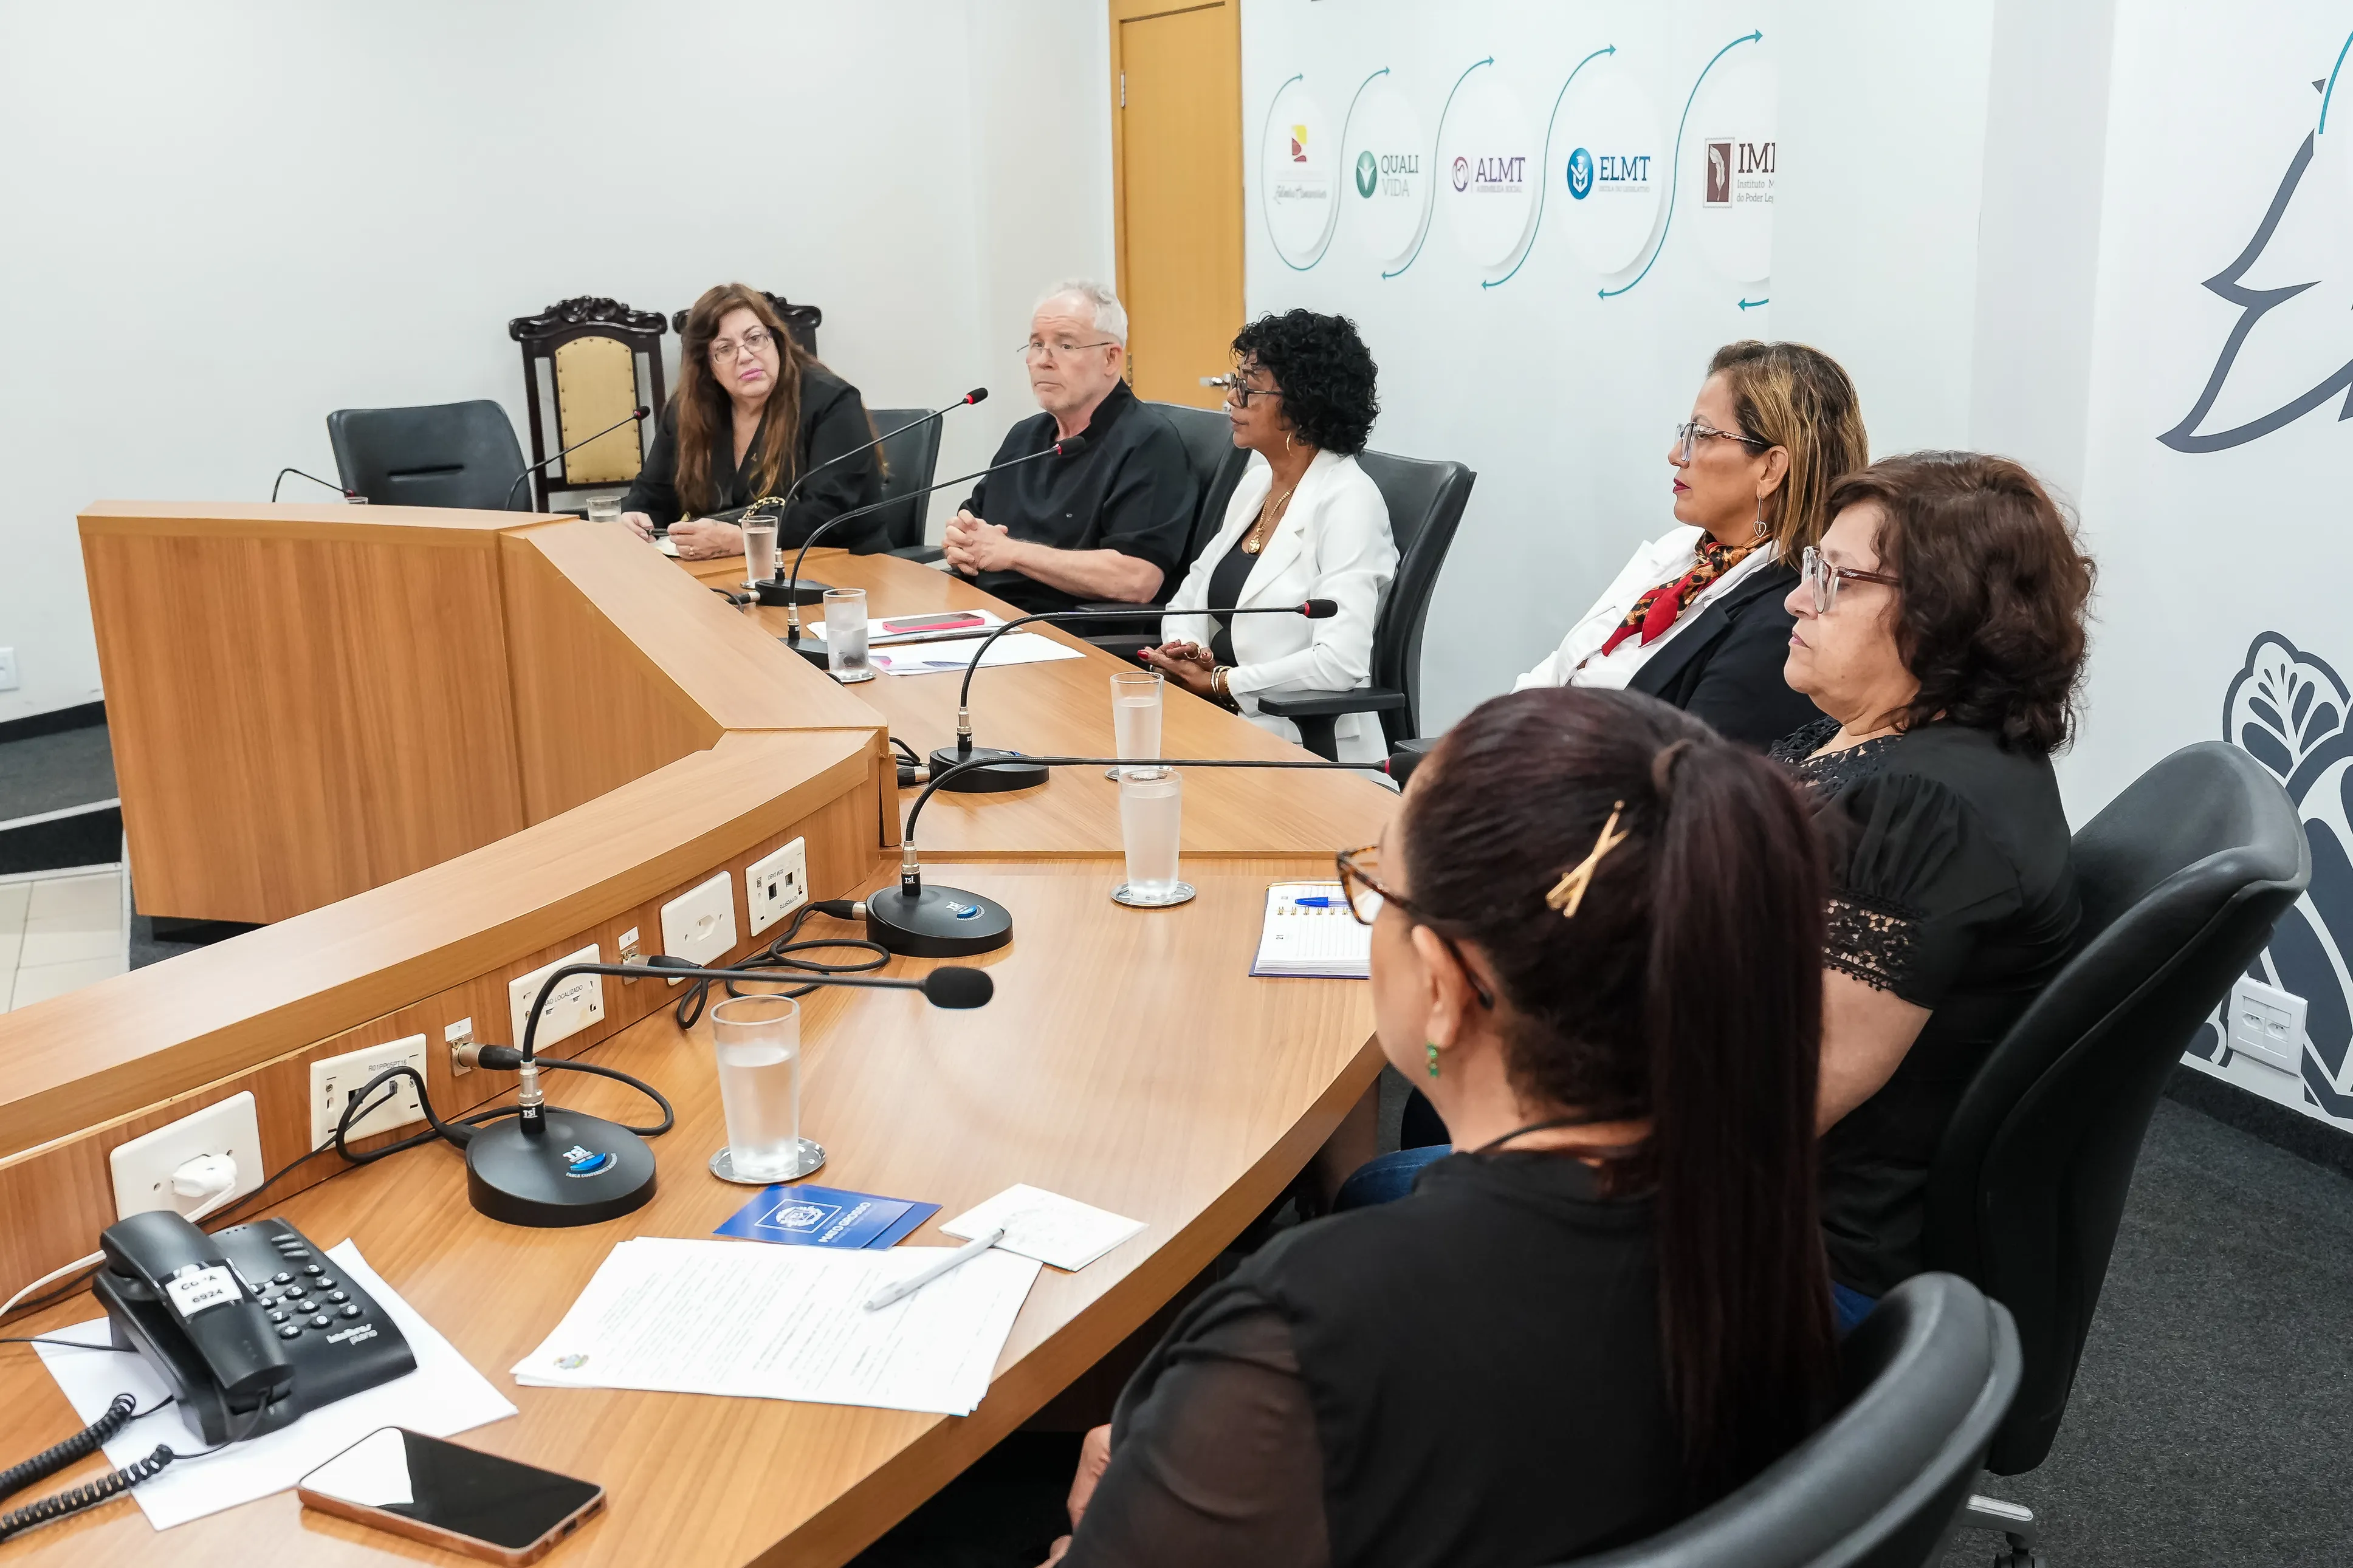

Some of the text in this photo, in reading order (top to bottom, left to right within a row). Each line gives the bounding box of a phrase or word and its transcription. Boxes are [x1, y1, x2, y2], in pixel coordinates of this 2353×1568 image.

[1381, 155, 1418, 176] QUALI
[1475, 157, 1525, 182] ALMT
[1599, 156, 1651, 181] ELMT
[1382, 179, 1410, 197] VIDA
[1737, 179, 1765, 188] Instituto
[1745, 193, 1763, 202] Poder
[555, 985, 583, 1002] LOCALIZADO
